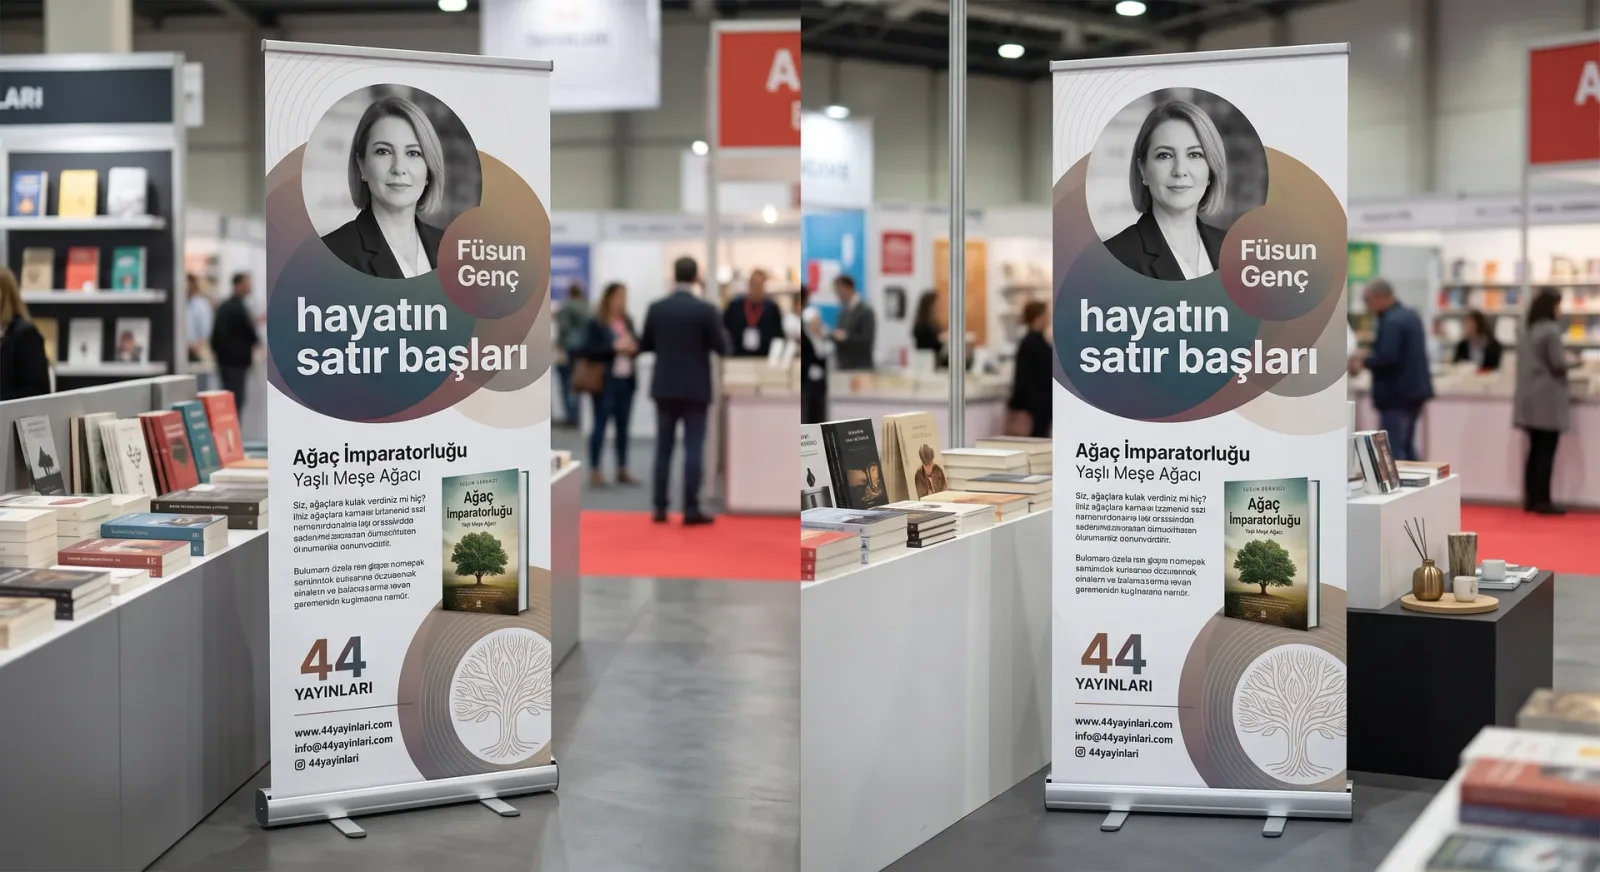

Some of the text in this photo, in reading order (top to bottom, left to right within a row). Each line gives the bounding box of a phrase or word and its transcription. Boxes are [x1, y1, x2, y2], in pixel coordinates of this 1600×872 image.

[0, 86, 43, 110] ARI
[457, 239, 526, 261] Füsun
[1240, 239, 1317, 261] Füsun
[457, 265, 519, 293] Genç
[1240, 265, 1309, 293] Genç
[297, 297, 447, 341] hayatın
[1079, 299, 1229, 341] hayatın
[296, 337, 528, 382] satır başları
[1079, 339, 1318, 384] satır başları
[292, 443, 468, 468] Ağaç İmparatorluğu
[1075, 439, 1250, 465] Ağaç İmparatorluğu
[293, 468, 421, 489] Yaşlı Meşe Ağacı
[1076, 465, 1202, 484] Yaşlı Meşe Ağacı
[293, 494, 426, 510] Siz, ağaçlara kulak verdiniz mi hiç?
[463, 489, 494, 507] Ağaç
[1075, 491, 1207, 505] Siz, ağaçlara kulak verdiniz mi hiç?
[1247, 496, 1281, 514] Ağaç
[446, 505, 513, 521] İmparatorluğu
[1229, 511, 1301, 529] İmparatorluğu
[300, 636, 367, 681] 44
[1080, 632, 1147, 675] 44
[294, 682, 373, 701] YAYINLARI
[1075, 677, 1153, 692] YAYINLARI
[294, 719, 393, 738] www.44yayinlari.com
[1074, 717, 1173, 730] www.44yayinlari.com
[294, 735, 394, 754] info@44yayinlari.com
[1074, 731, 1174, 745] info@44yayinlari.com
[308, 753, 359, 768] 44yayinlari
[1088, 748, 1139, 759] 44yayinlari
